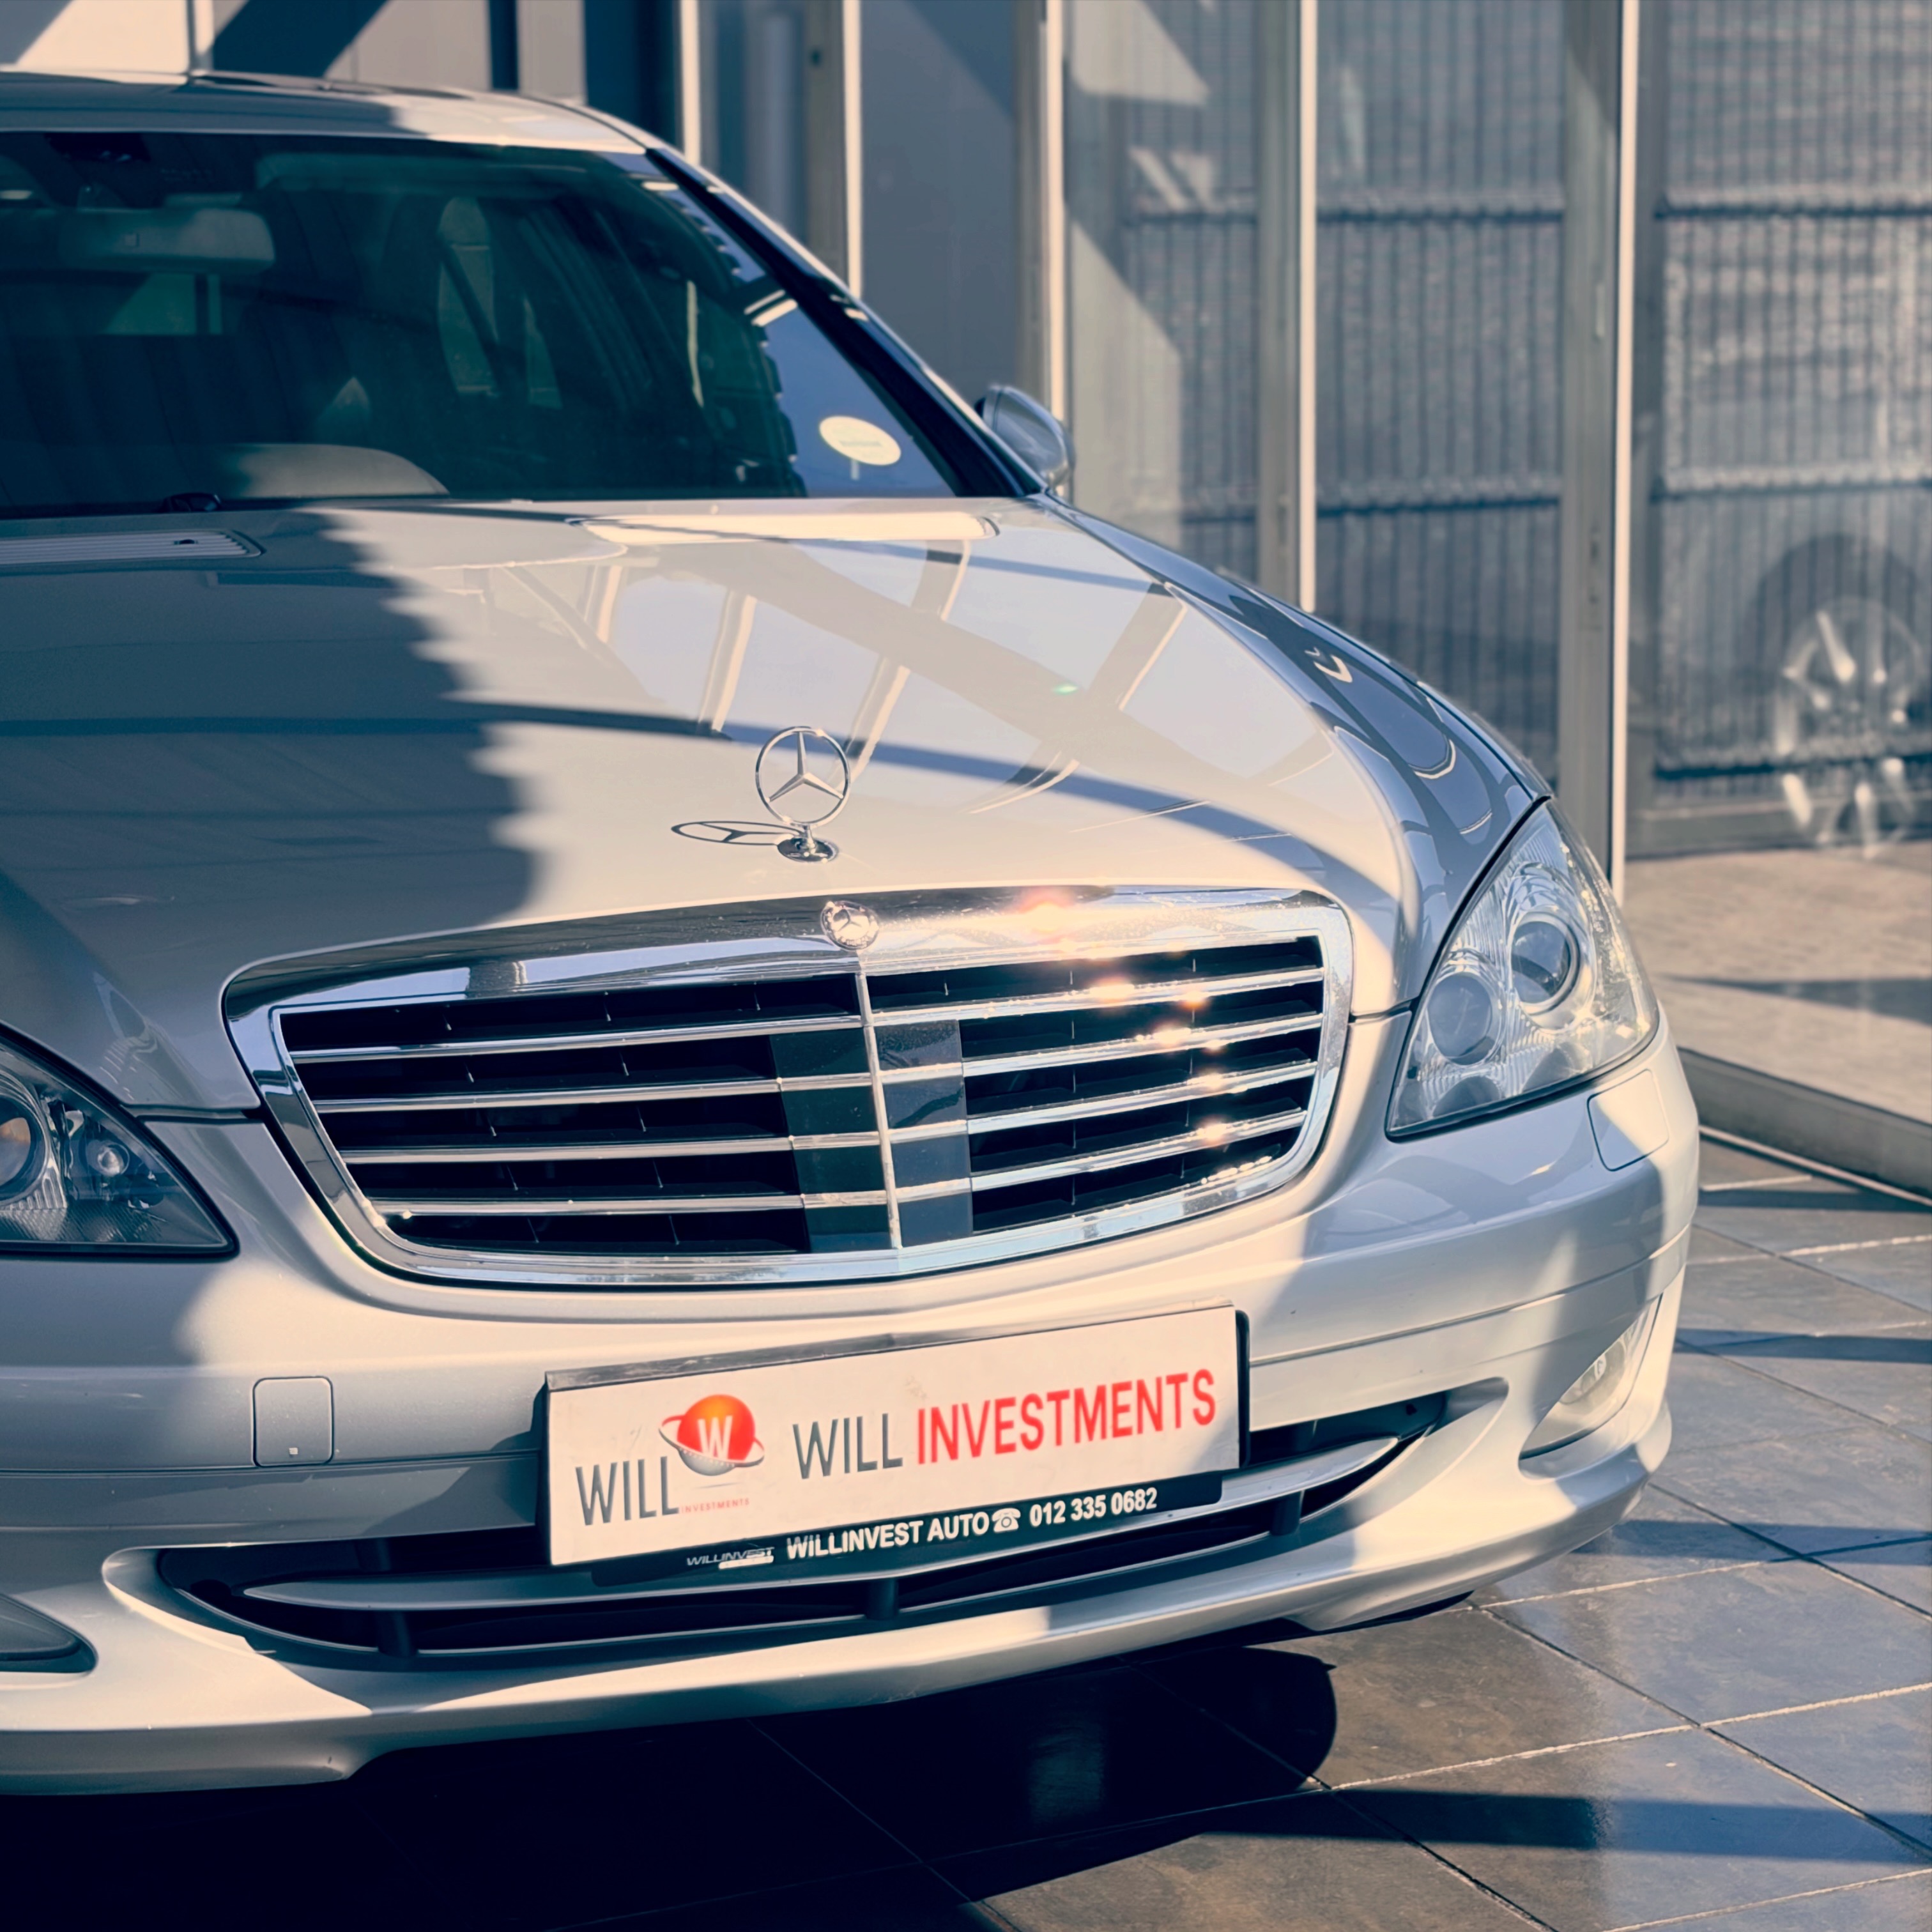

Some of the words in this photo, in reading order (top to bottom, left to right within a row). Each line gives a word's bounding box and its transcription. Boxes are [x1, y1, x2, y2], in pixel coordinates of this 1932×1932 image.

[698, 1415, 733, 1460] W
[793, 1413, 903, 1480] WILL
[918, 1368, 1216, 1465] INVESTMENTS
[576, 1455, 680, 1526] WILL
[682, 1498, 750, 1514] INVESTMENTS
[786, 1520, 924, 1560] WILLINVEST
[927, 1512, 990, 1542] AUTO
[1029, 1500, 1066, 1527] 012
[1071, 1494, 1107, 1521] 335
[1111, 1487, 1157, 1514] 0682
[687, 1546, 774, 1566] WILLINVEST
